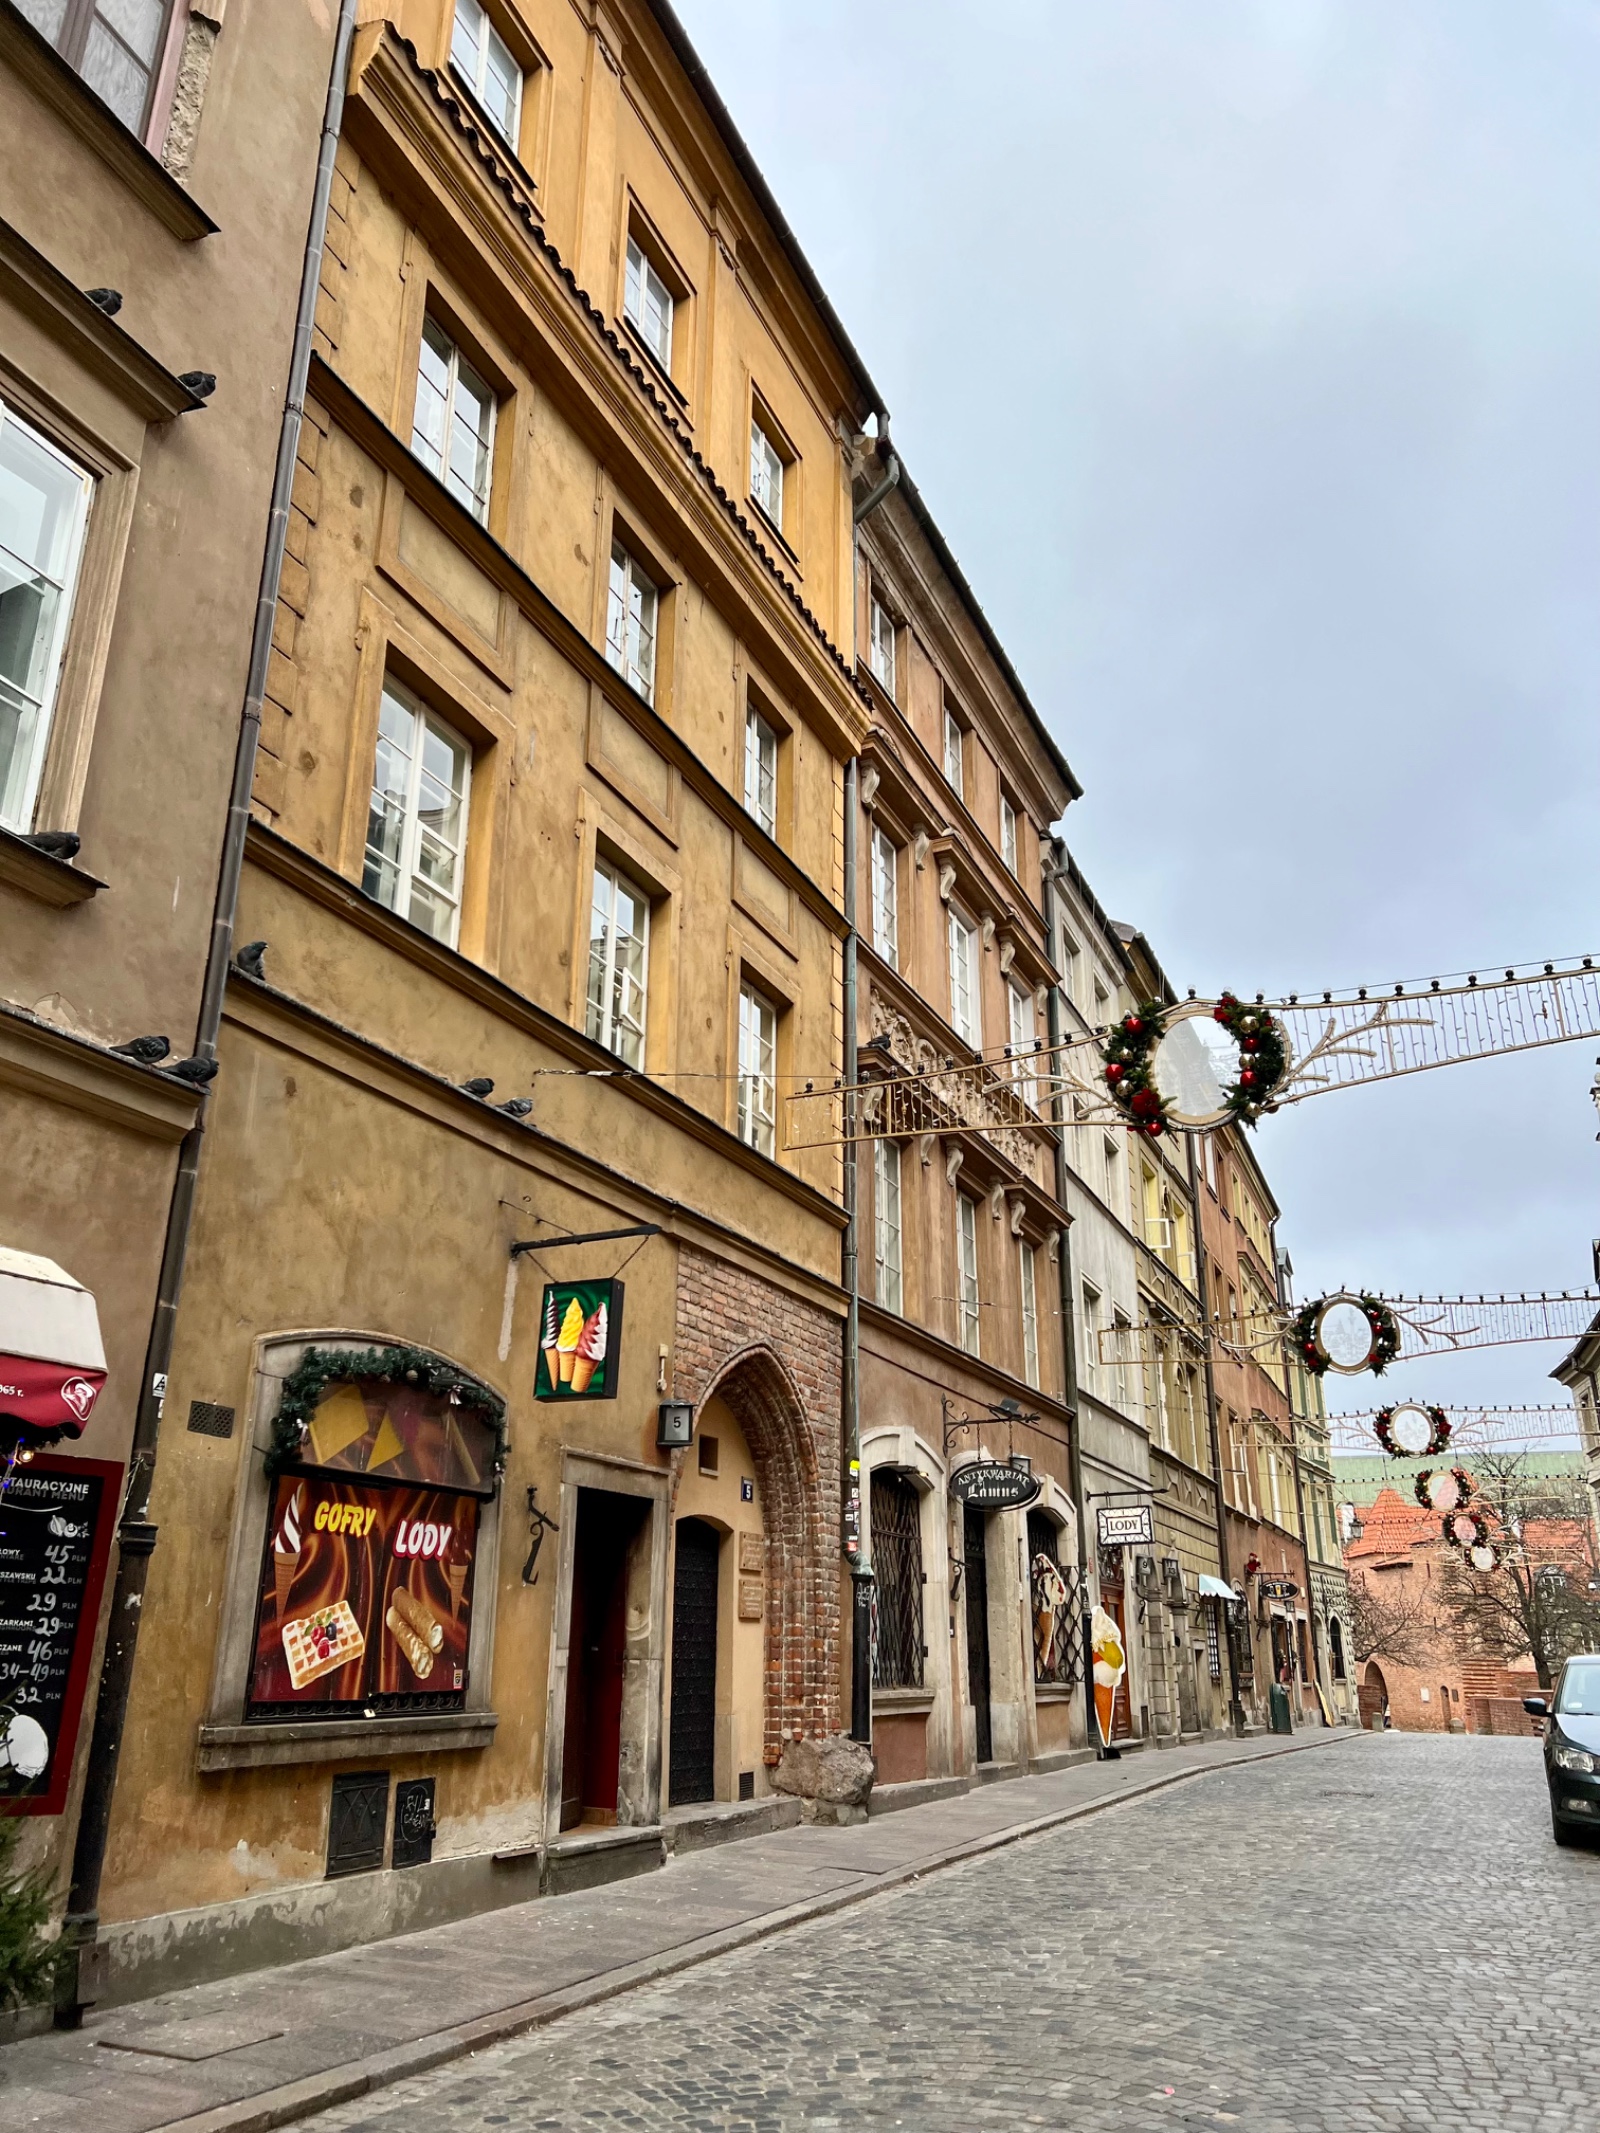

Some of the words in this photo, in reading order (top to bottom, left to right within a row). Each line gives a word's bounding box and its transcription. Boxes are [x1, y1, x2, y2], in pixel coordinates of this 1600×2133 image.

[673, 1416, 682, 1428] 5
[958, 1469, 1030, 1489] ANTYKWARIAT
[745, 1485, 751, 1499] 5
[314, 1501, 377, 1538] GOFRY
[1110, 1520, 1138, 1531] LODY
[395, 1519, 452, 1557] LODY
[44, 1545, 75, 1564] 45
[71, 1554, 86, 1562] PLN
[1142, 1560, 1148, 1568] 9
[40, 1565, 66, 1584] 22
[26, 1592, 56, 1612] 29
[35, 1617, 60, 1636] 29
[27, 1639, 52, 1662] 46
[15, 1686, 42, 1704] 32
[45, 1692, 61, 1700] PLN
